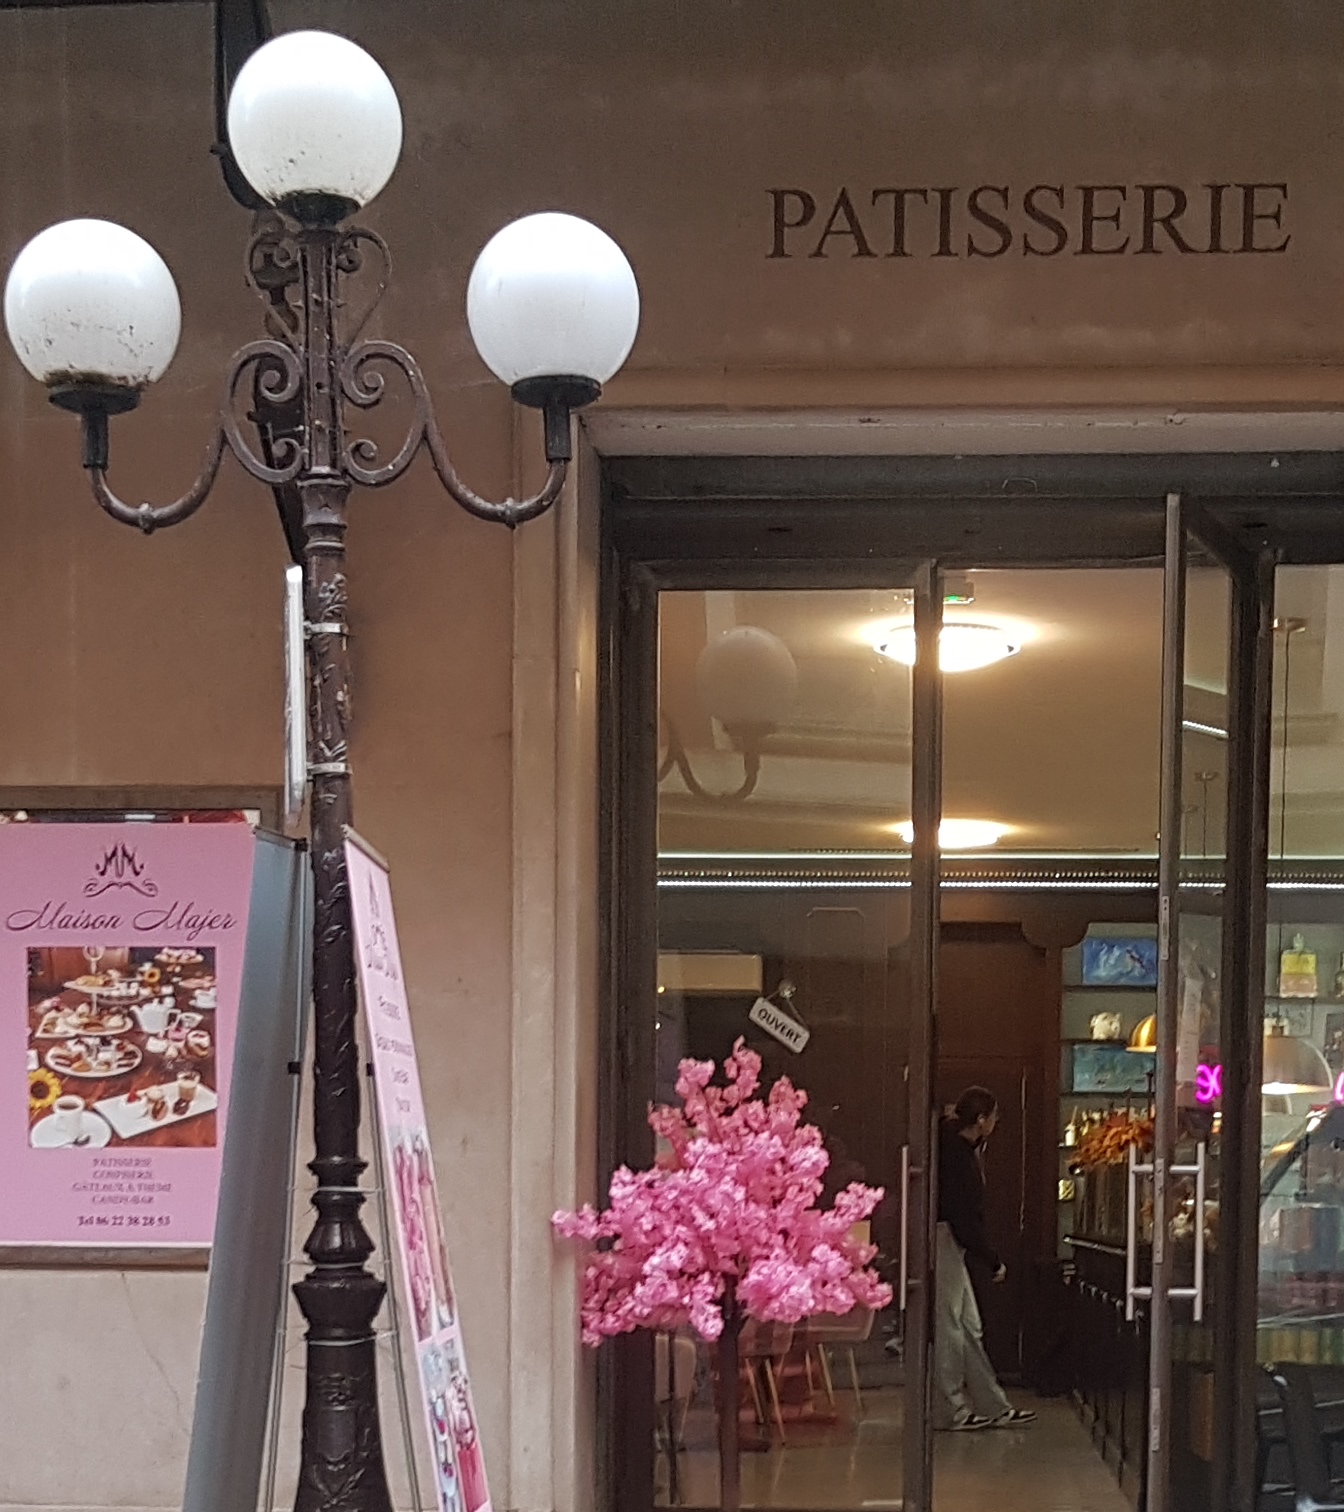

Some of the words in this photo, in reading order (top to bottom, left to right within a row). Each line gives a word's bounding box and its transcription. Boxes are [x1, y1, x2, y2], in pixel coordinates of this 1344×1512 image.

[764, 182, 1292, 259] PATISSERIE
[6, 901, 122, 931] Maison
[133, 901, 237, 941] Majer
[758, 1007, 803, 1044] OUVERT
